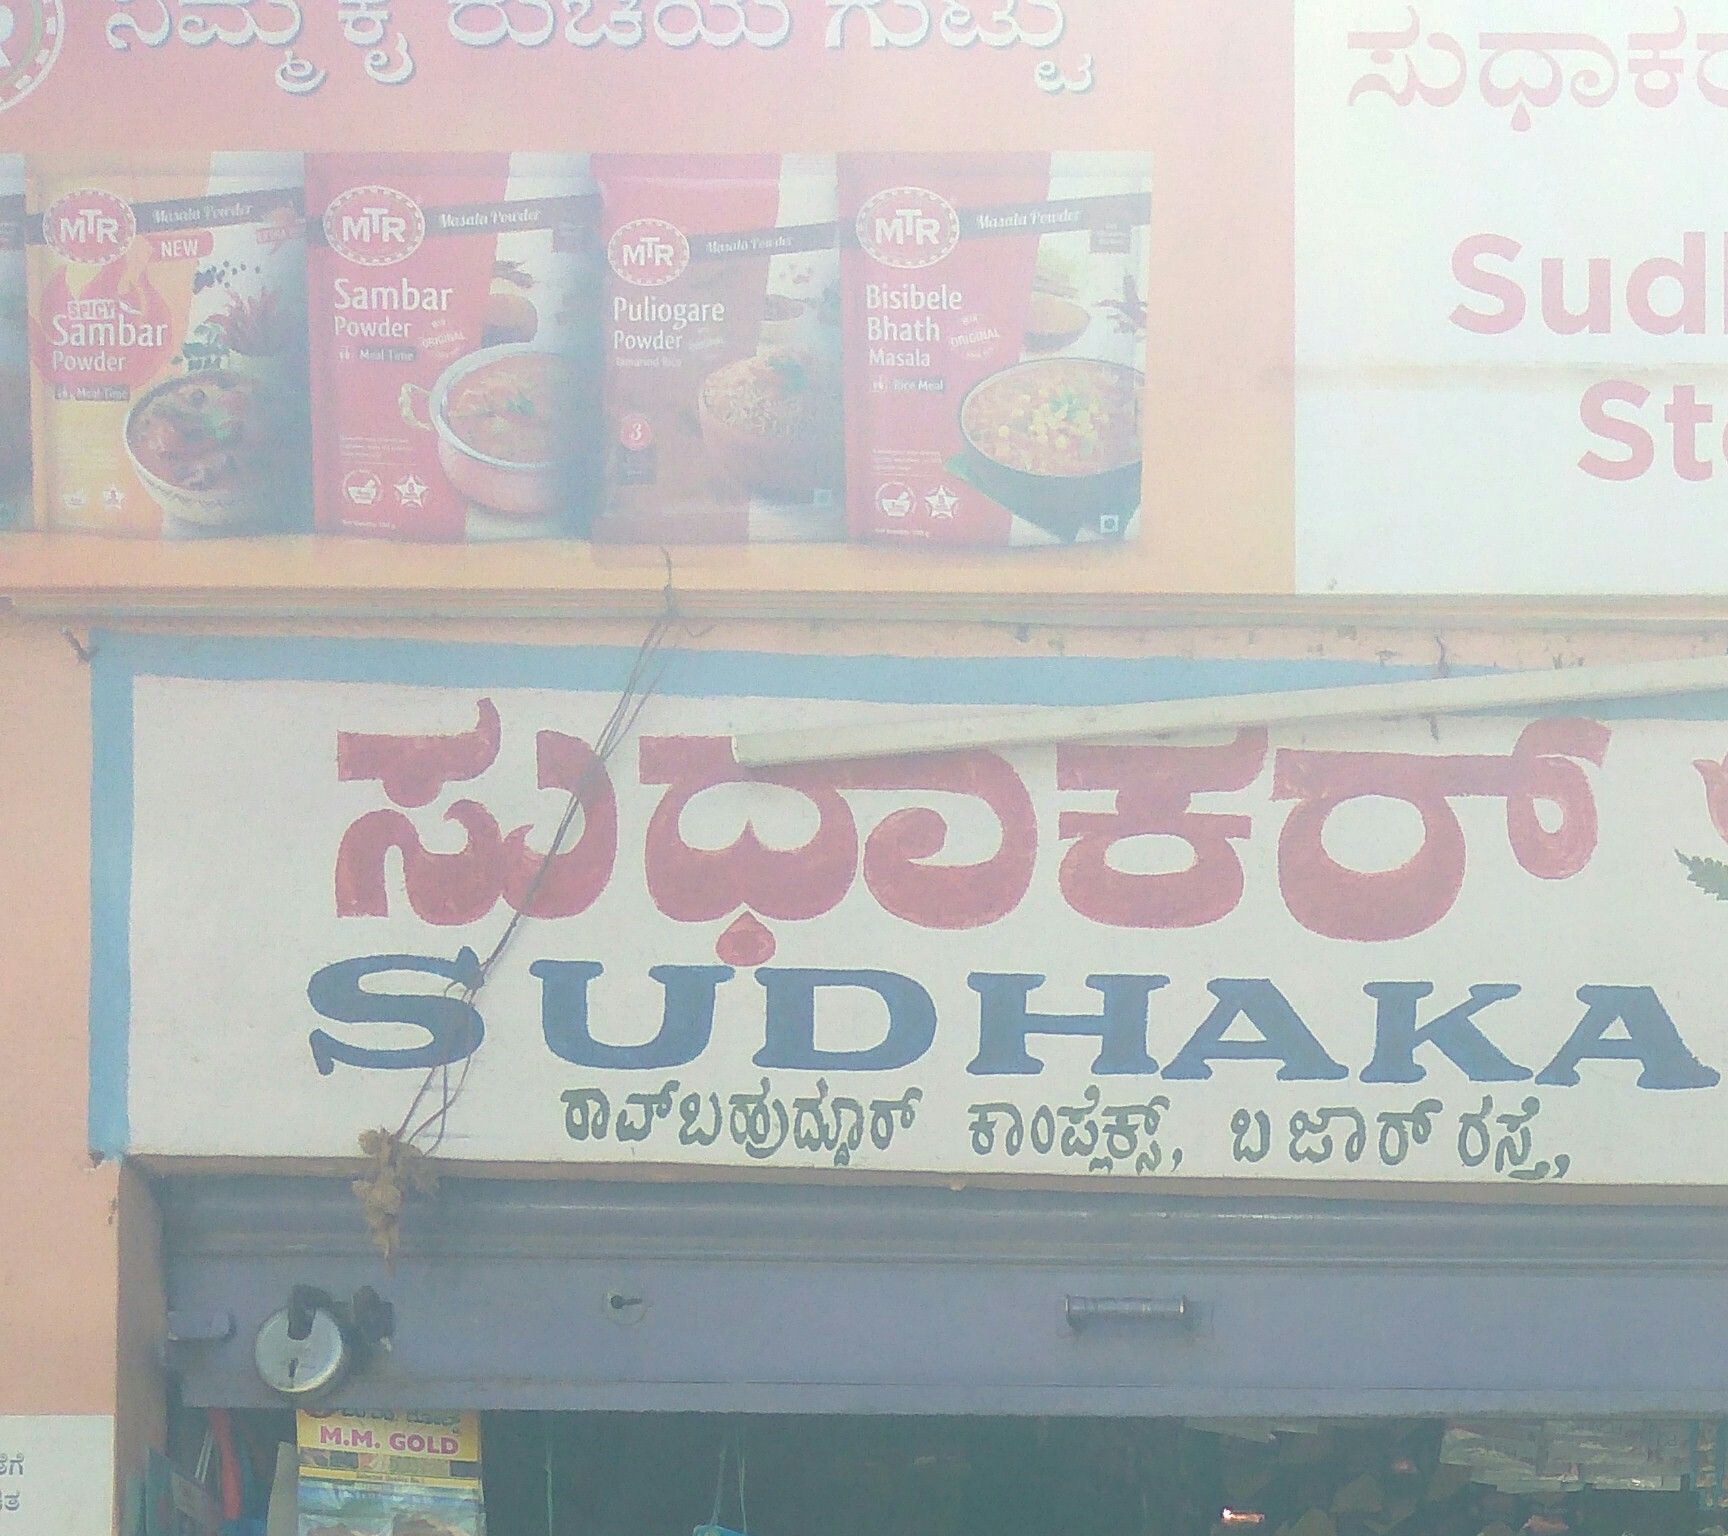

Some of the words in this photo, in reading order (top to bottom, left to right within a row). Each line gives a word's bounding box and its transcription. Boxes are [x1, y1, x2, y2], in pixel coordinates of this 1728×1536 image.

[59, 207, 120, 245] MTR
[341, 206, 408, 244] MTR
[438, 210, 490, 229] Masala
[491, 206, 542, 227] Powder
[873, 207, 942, 247] MTR
[160, 239, 199, 258] NEW
[622, 235, 675, 268] MTR
[333, 277, 454, 312] Sambar
[865, 283, 964, 312] Bisibele
[333, 315, 413, 339] Powder
[612, 295, 727, 330] Puliogare
[51, 314, 169, 348] Sambar
[612, 328, 685, 352] Powder
[866, 313, 942, 343] Bhath
[51, 350, 127, 373] Powder
[867, 346, 932, 369] Masala
[335, 697, 1612, 967] ಸುಧಾಕರ್
[319, 1425, 381, 1449] M.M.
[388, 1431, 460, 1455] GOLD
